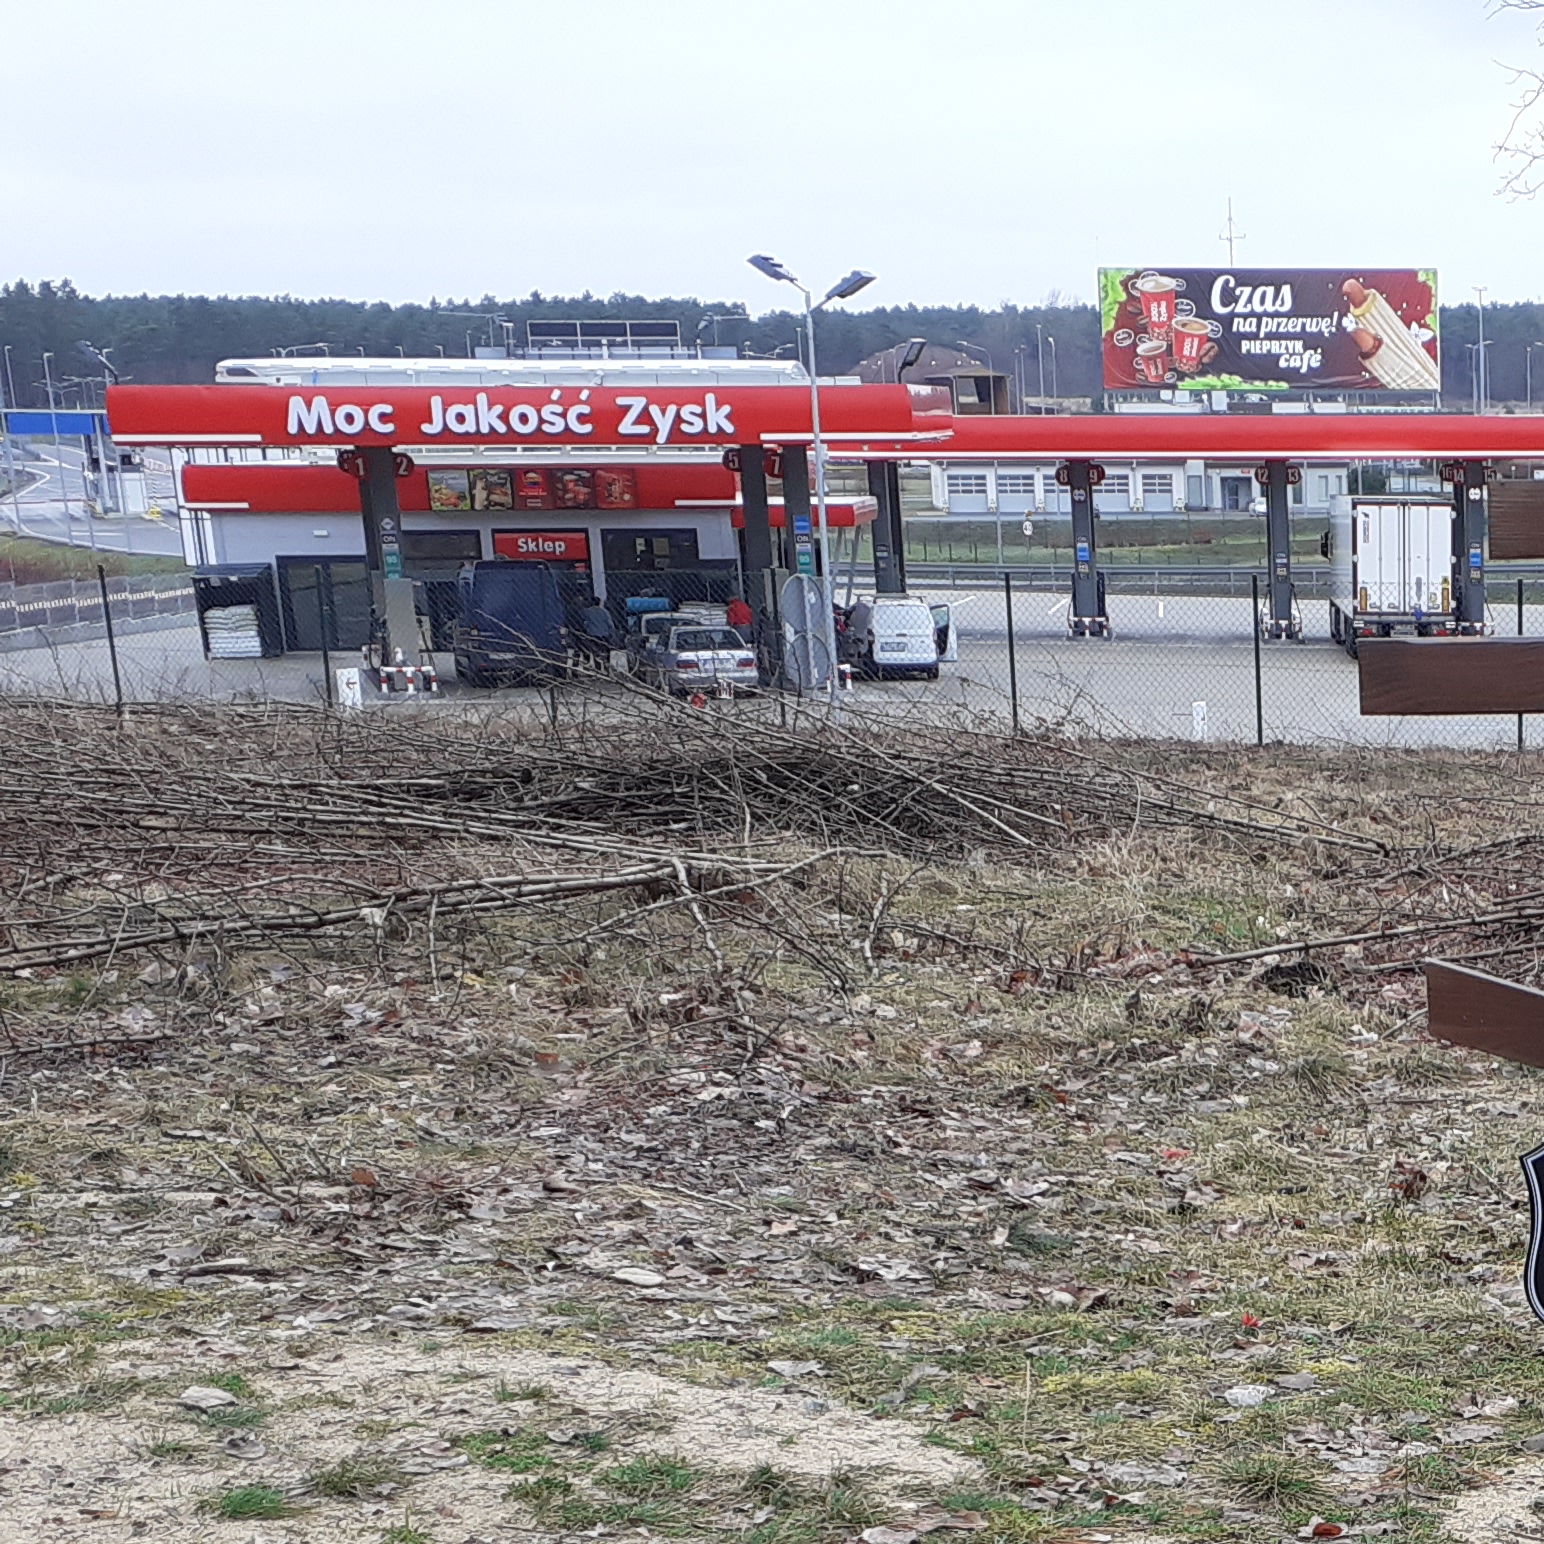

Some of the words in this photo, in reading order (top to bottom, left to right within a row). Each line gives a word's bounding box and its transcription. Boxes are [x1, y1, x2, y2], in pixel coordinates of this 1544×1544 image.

[1211, 274, 1293, 314] Czas
[1232, 317, 1258, 333] na
[1259, 311, 1339, 339] przerwę!
[1241, 340, 1304, 354] PIEPRZYK
[1278, 347, 1322, 374] café
[287, 395, 395, 434] Moc
[420, 389, 594, 434] Jakość
[615, 392, 735, 444] Zysk
[355, 457, 365, 476] 1
[396, 456, 408, 475] 2
[728, 451, 739, 469] 5
[1059, 469, 1068, 483] 8
[1089, 469, 1098, 483] 9
[1257, 468, 1269, 483] 12
[1287, 468, 1299, 482] 13
[517, 537, 566, 555] Sklep
